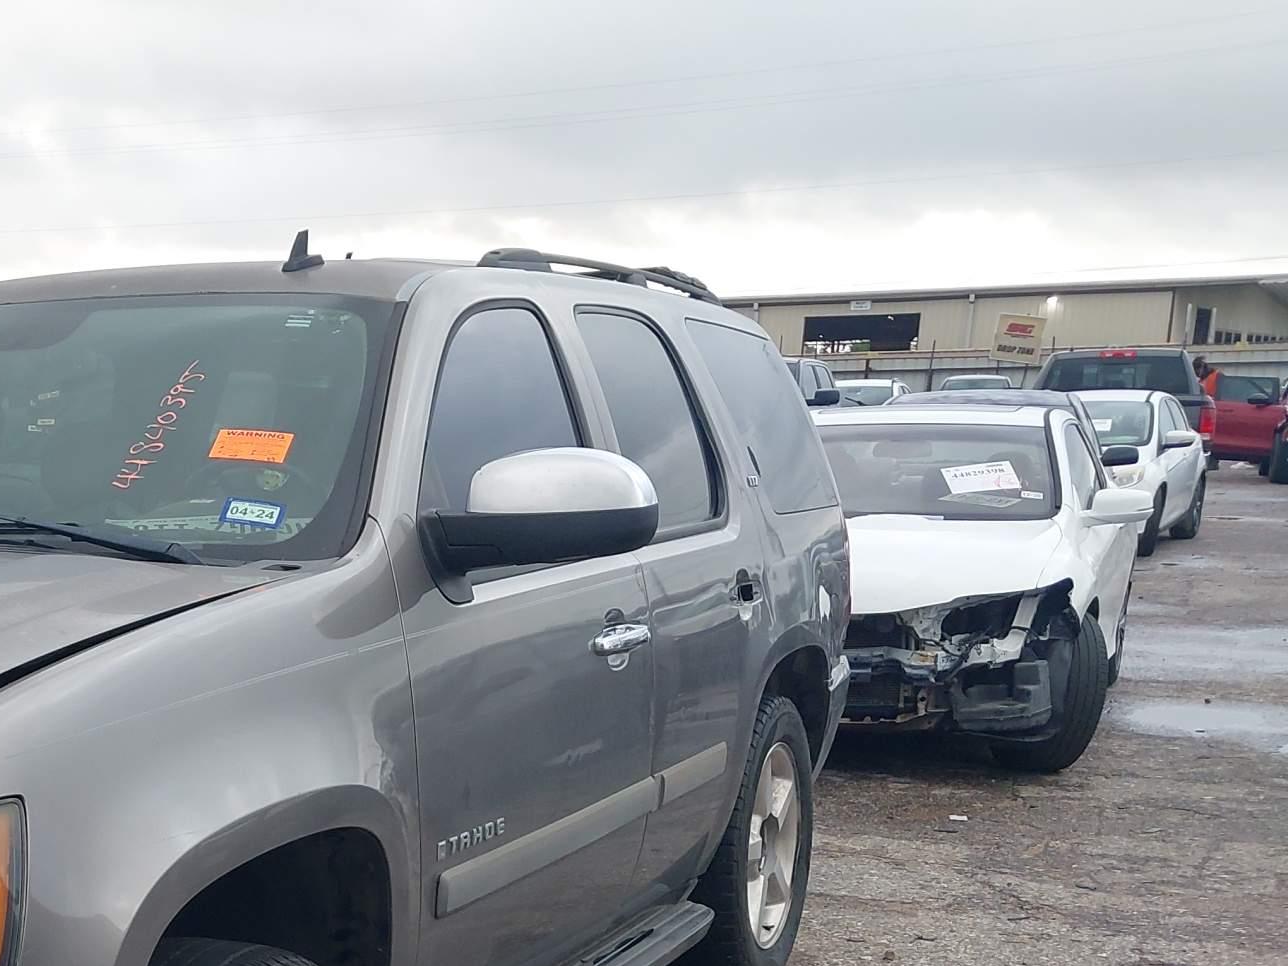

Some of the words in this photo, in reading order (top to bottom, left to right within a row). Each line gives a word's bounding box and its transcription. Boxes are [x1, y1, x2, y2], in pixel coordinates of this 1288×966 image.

[112, 359, 205, 489] 44840395
[226, 430, 286, 440] WARNING
[449, 817, 505, 854] TAHOE
